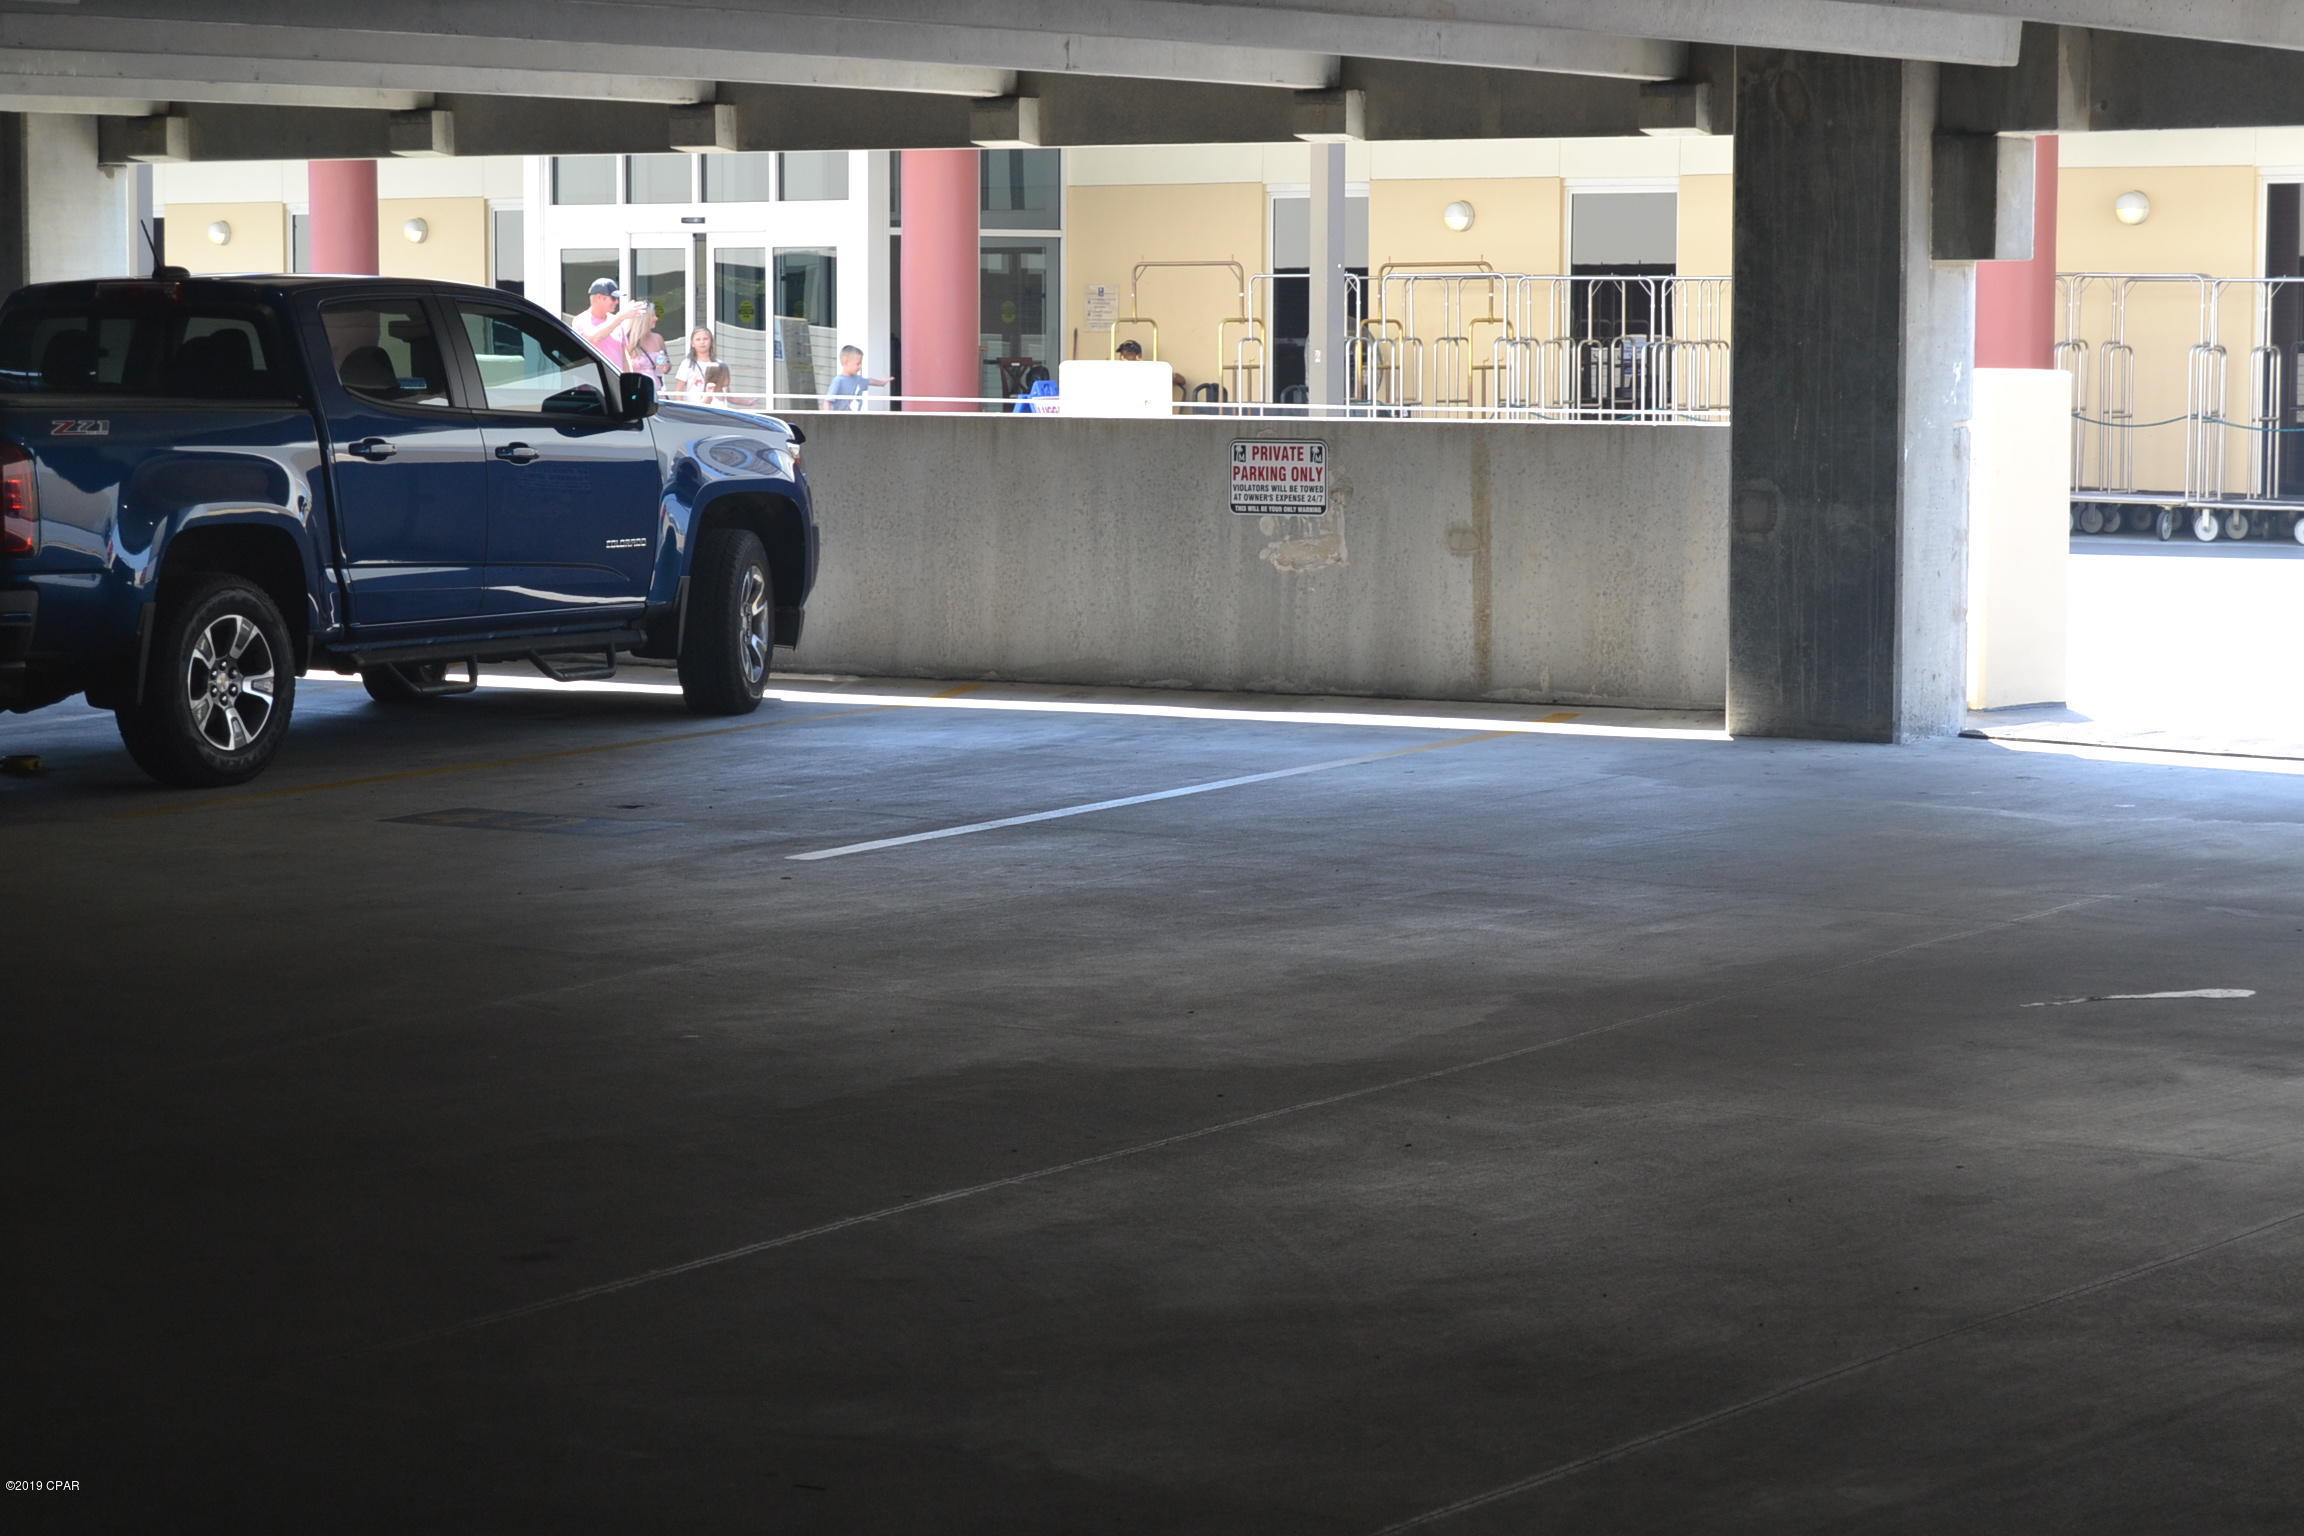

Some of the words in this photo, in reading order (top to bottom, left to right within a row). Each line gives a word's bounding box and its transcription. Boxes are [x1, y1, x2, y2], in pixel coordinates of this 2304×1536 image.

[51, 419, 110, 436] Z71
[1251, 445, 1305, 462] PRIVATE
[1232, 465, 1287, 482] PARKING
[1291, 466, 1324, 482] ONLY
[1232, 484, 1270, 492] VIOLATORS
[1271, 485, 1288, 493] WILL
[1289, 485, 1298, 493] BE
[1300, 485, 1324, 493] TOWED
[1233, 493, 1242, 501] AT
[1243, 494, 1274, 502] OWNER'S
[1276, 494, 1306, 502] EXPENSE
[1307, 495, 1323, 503] 24/7
[605, 537, 647, 549] COLORADO
